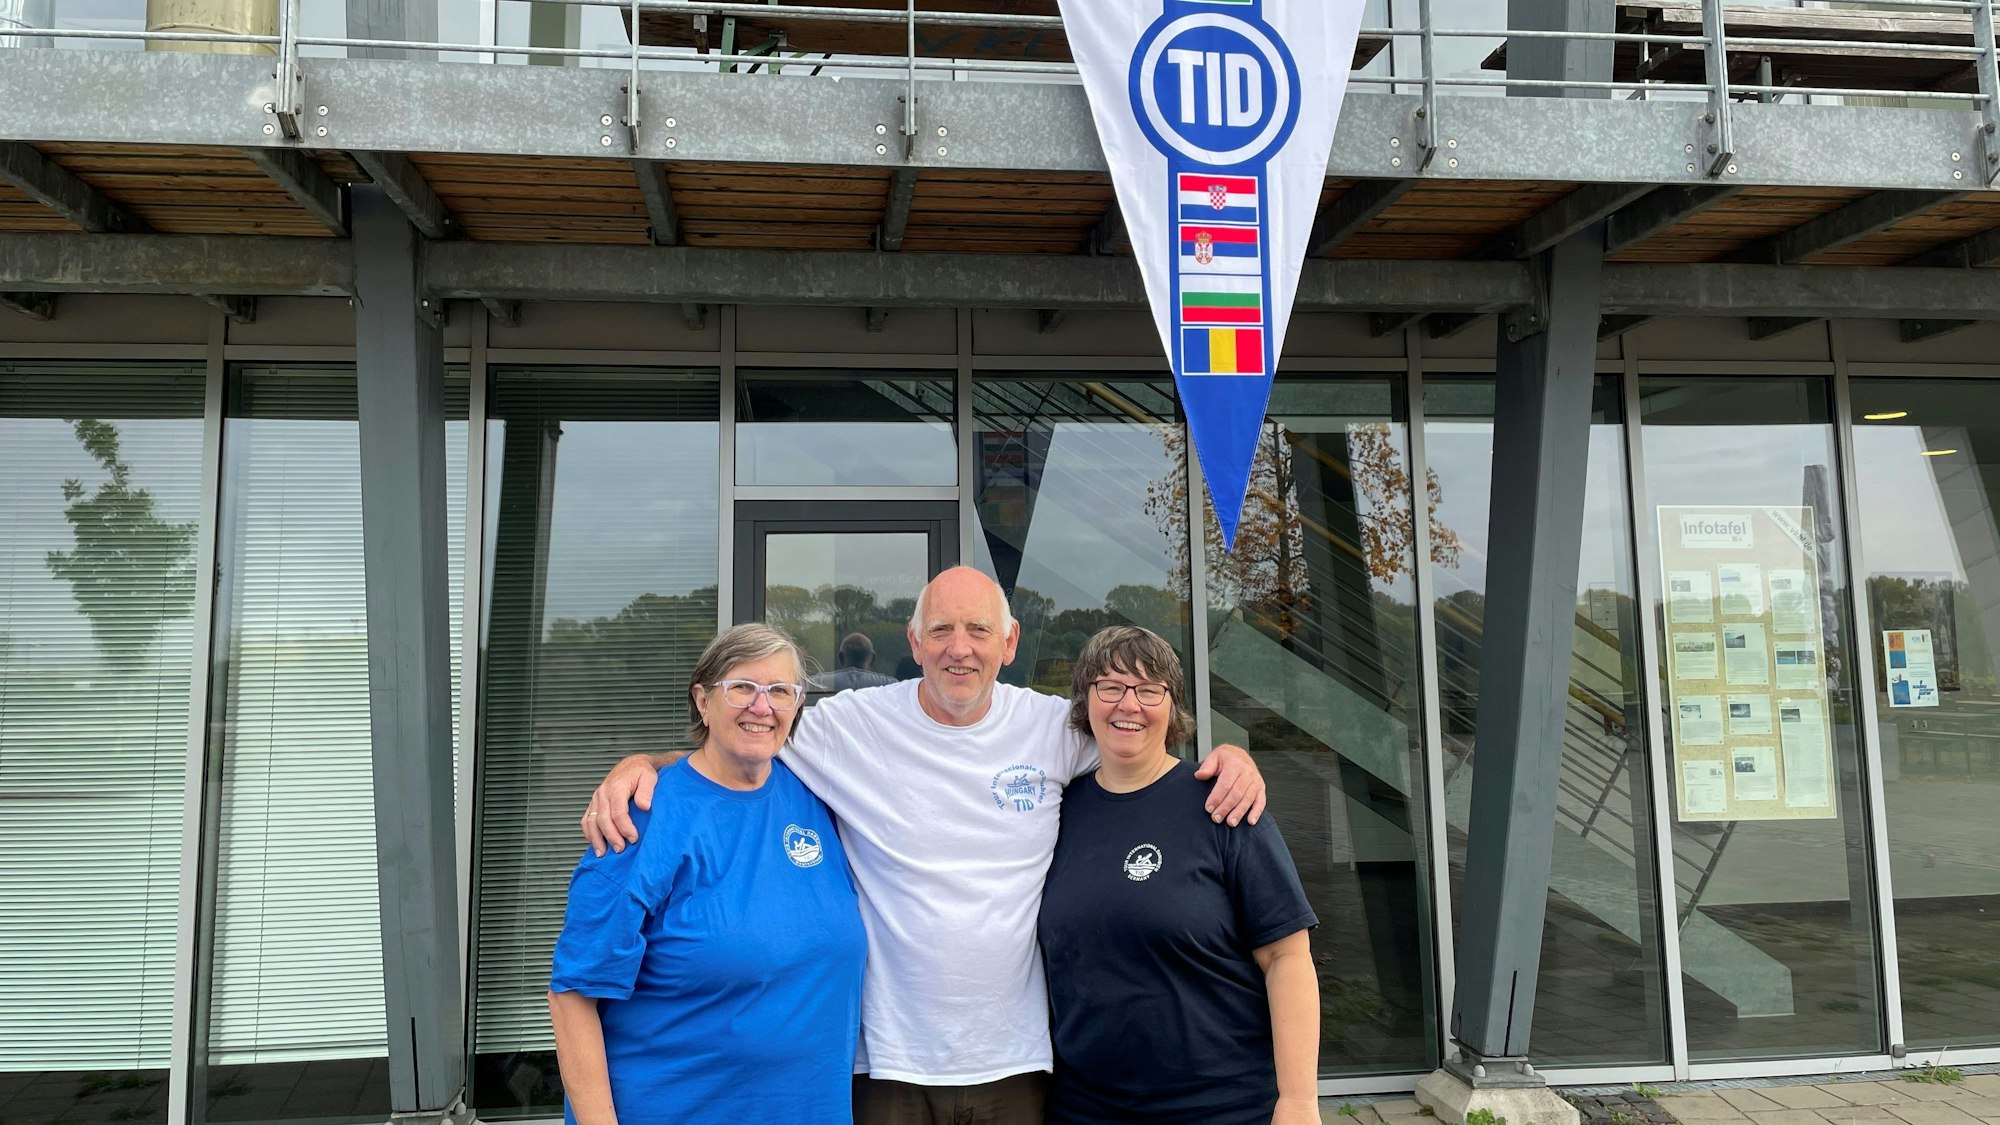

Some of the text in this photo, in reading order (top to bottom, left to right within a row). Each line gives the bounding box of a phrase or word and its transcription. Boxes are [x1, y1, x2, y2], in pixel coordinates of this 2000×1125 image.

[1168, 49, 1263, 127] TID
[1683, 521, 1746, 535] Infotafel
[991, 764, 1037, 789] Inteacionale
[1004, 785, 1036, 799] HUNGARY
[992, 791, 1005, 810] Tour
[1014, 798, 1034, 812] TID
